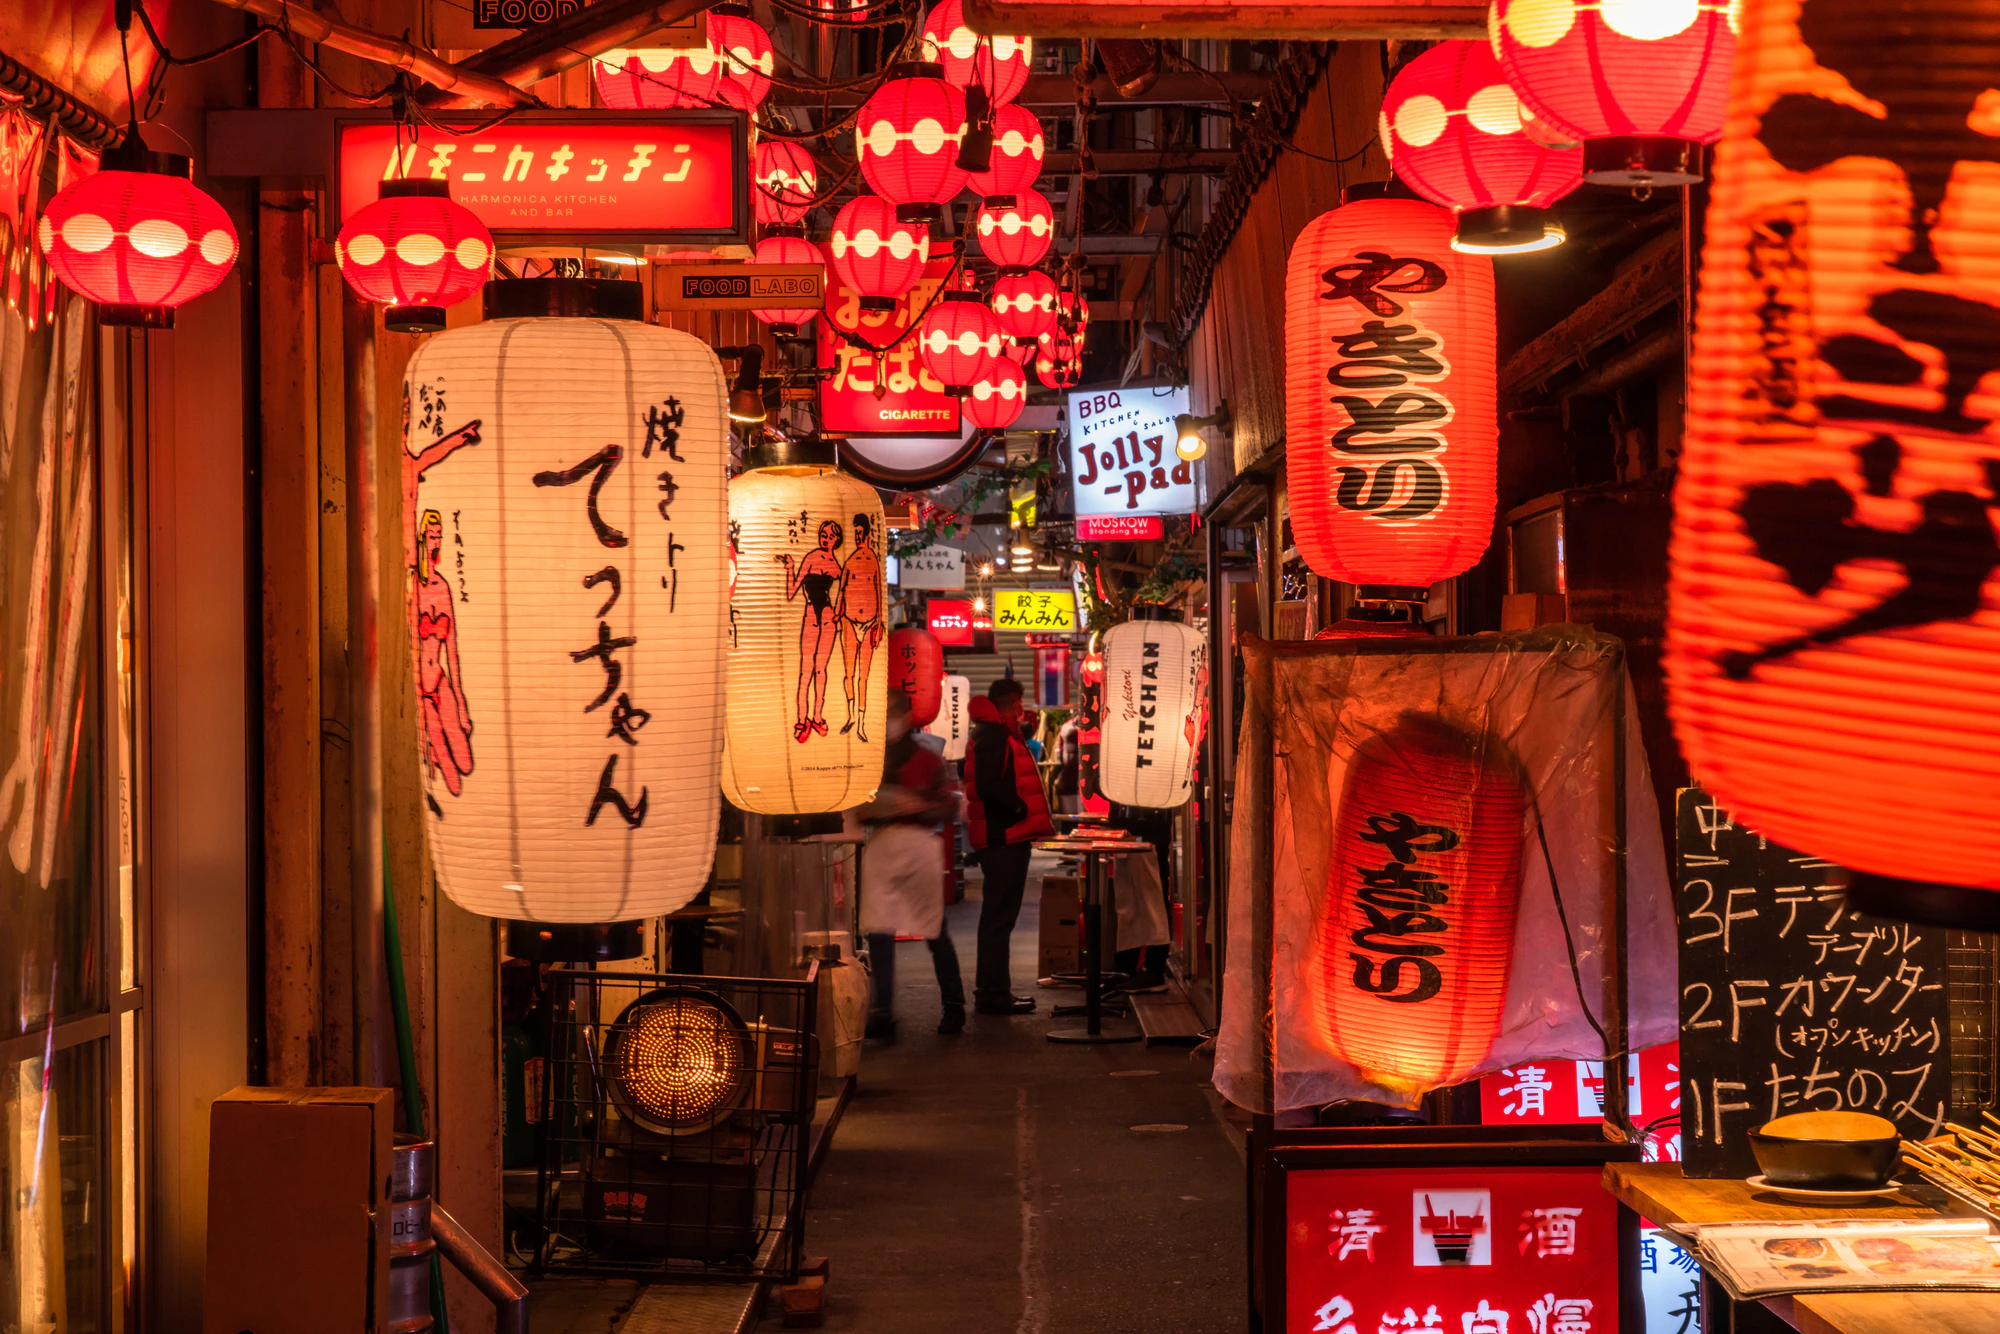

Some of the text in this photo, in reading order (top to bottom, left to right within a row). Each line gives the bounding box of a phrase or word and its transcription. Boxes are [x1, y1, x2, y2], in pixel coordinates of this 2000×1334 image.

[383, 143, 692, 182] ハモニカキッチン
[460, 195, 618, 204] HARMONICA KITCHEN
[509, 208, 574, 217] AND BAR
[686, 278, 815, 295] FOOD LABO
[879, 410, 951, 420] CIGARETTE
[1079, 392, 1122, 419] BBQ
[1083, 410, 1141, 436] KITCHEN
[1144, 416, 1176, 430] SALOO
[1078, 431, 1163, 485] Jolly
[641, 395, 686, 613] 焼きトリ
[1089, 517, 1148, 528] MOSKOW
[1089, 527, 1148, 536] Standing Bar
[904, 560, 954, 570] あんちゃん
[999, 609, 1069, 626] みんみん
[1017, 594, 1052, 608] 餃子
[532, 444, 652, 830] てっちゃん
[952, 686, 960, 740] TETCHAN
[1123, 668, 1138, 722] Yakitori
[1136, 642, 1160, 768] TETCHAN
[1684, 879, 1862, 953] 3F テラ
[1807, 923, 1922, 965] テーブル
[1681, 978, 1770, 1043] 2F
[1499, 1065, 1553, 1117] 清
[1690, 1078, 1750, 1145] 1F
[1327, 1208, 1388, 1263] 清
[1517, 1206, 1583, 1259] 酒
